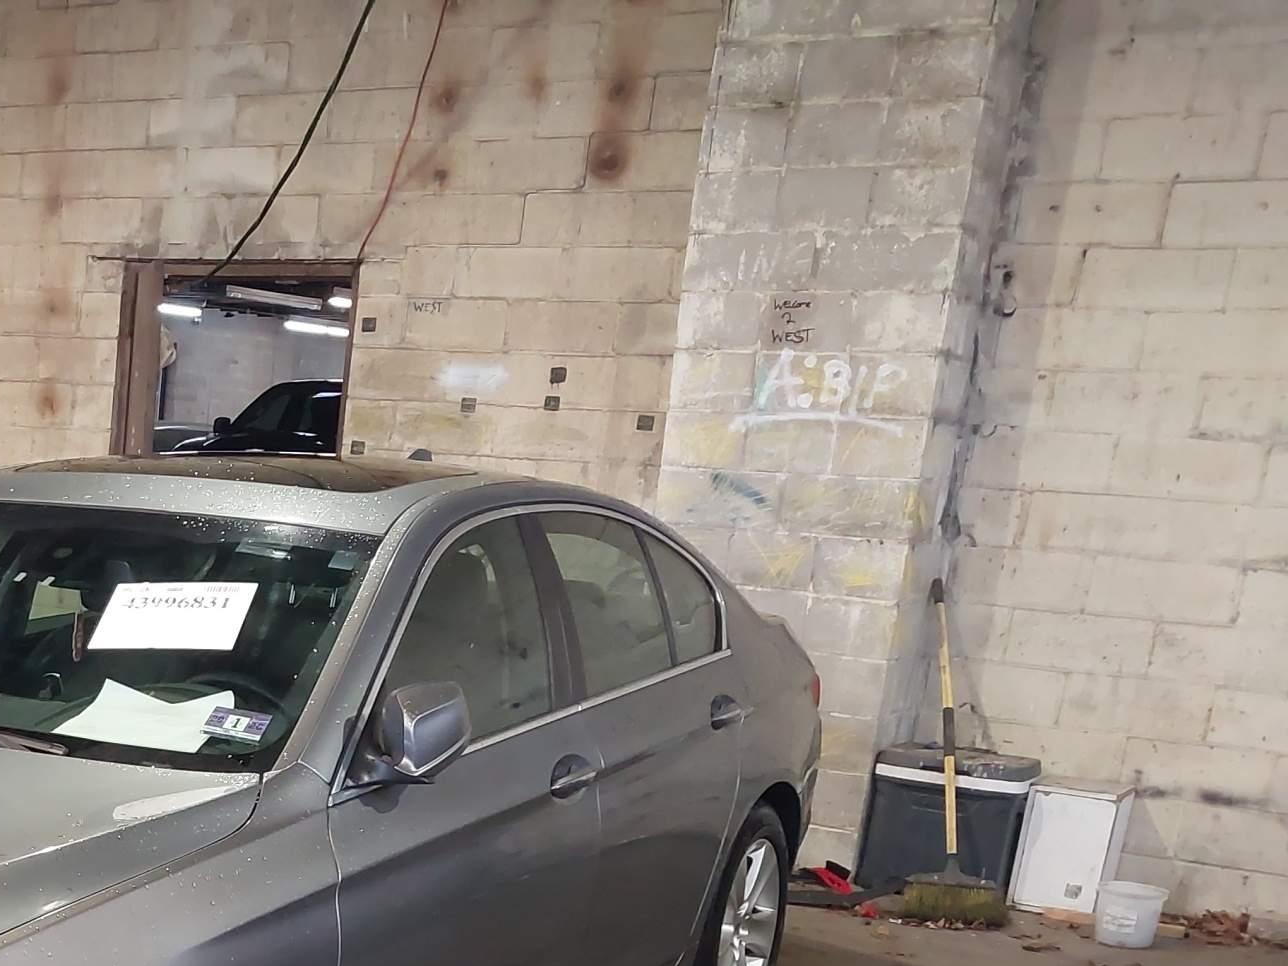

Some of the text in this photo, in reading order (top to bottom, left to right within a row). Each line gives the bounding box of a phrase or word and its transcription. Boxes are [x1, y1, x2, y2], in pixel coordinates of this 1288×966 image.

[413, 302, 443, 313] WEST
[781, 311, 796, 324] 2
[771, 328, 815, 344] WEST
